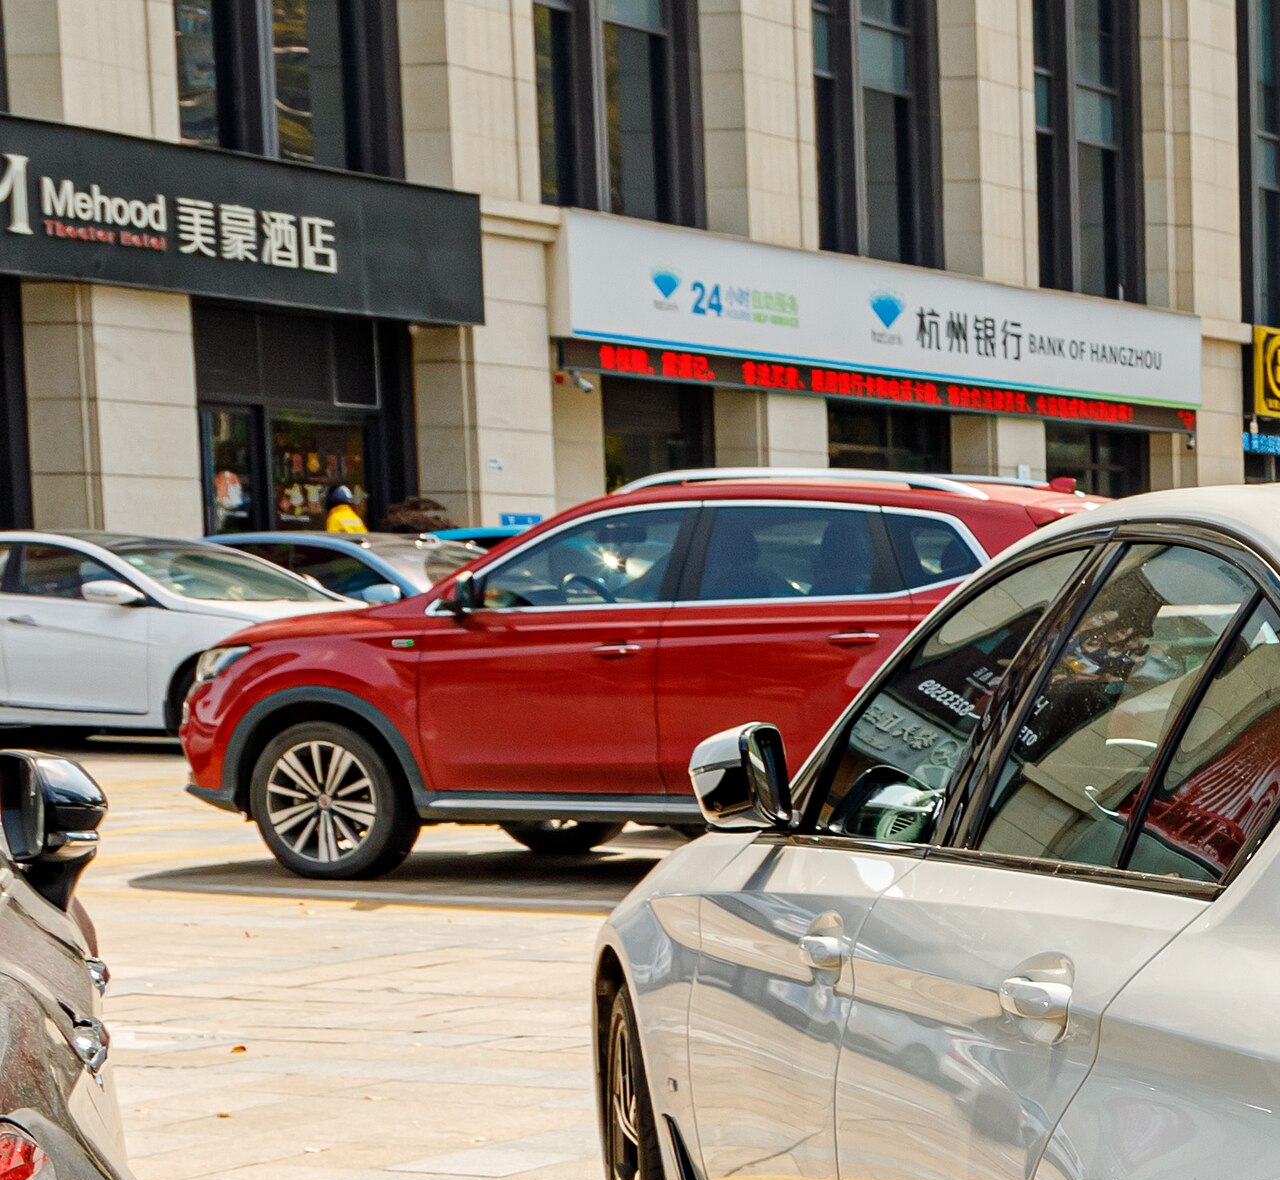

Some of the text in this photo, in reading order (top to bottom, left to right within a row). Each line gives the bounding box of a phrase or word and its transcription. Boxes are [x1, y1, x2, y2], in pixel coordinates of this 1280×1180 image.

[41, 176, 168, 232] Mehood
[177, 198, 338, 274] 美豪酒店
[691, 281, 722, 317] 24
[916, 306, 1023, 361] 杭州银行
[1028, 333, 1163, 371] BANK OF HANGZHOU
